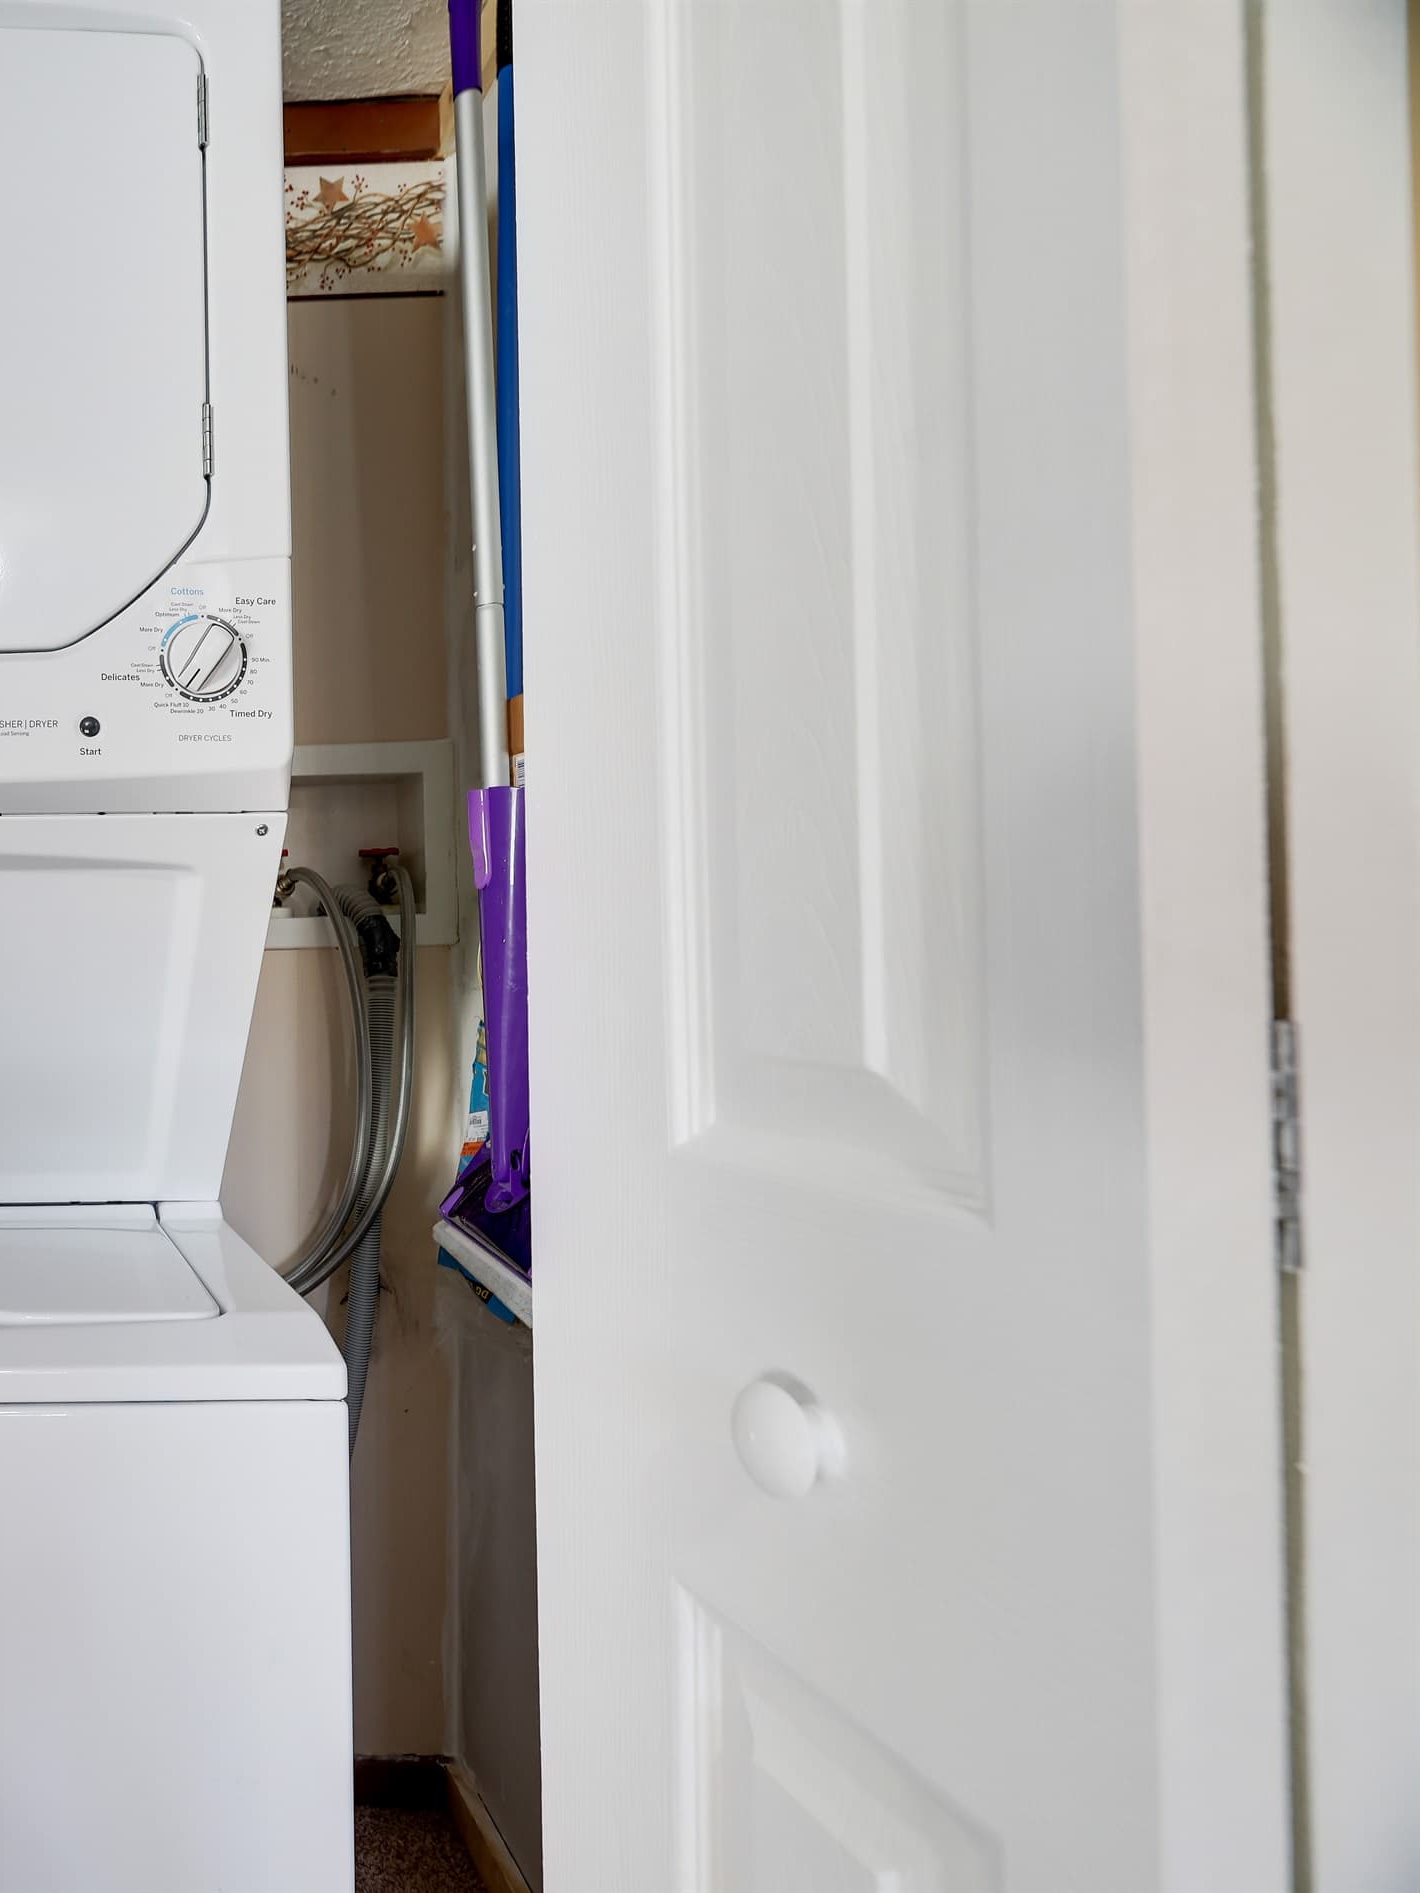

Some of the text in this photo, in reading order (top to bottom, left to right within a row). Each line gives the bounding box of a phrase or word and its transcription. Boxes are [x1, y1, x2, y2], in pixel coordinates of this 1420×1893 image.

[235, 597, 276, 606] Easy Care
[101, 673, 141, 681] Delicates
[257, 710, 273, 719] Dry
[29, 720, 58, 728] DRYER
